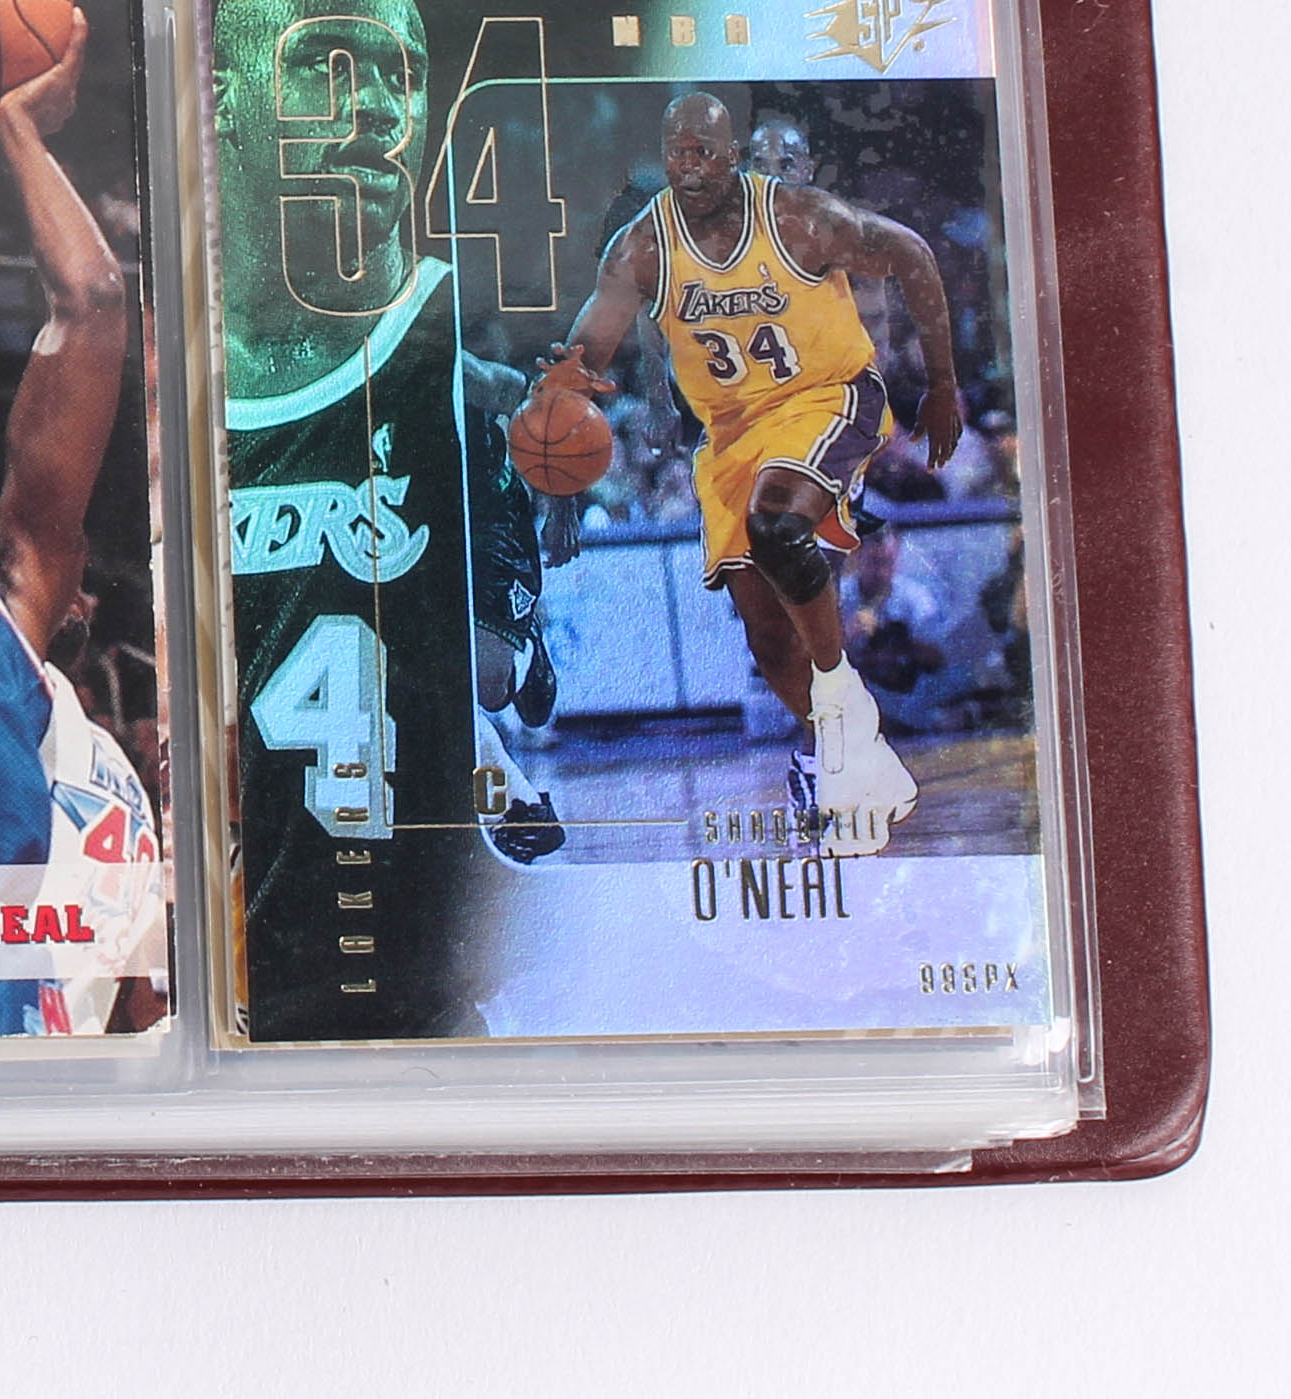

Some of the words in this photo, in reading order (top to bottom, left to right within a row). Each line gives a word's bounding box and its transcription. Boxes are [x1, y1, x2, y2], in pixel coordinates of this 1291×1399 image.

[275, 14, 567, 316] 34
[677, 279, 790, 326] LAKERS
[689, 321, 803, 387] 34
[472, 765, 507, 816] C
[333, 762, 377, 993] LAKERS
[691, 857, 851, 921] O'NEAL
[920, 961, 1019, 995] 99SPX
